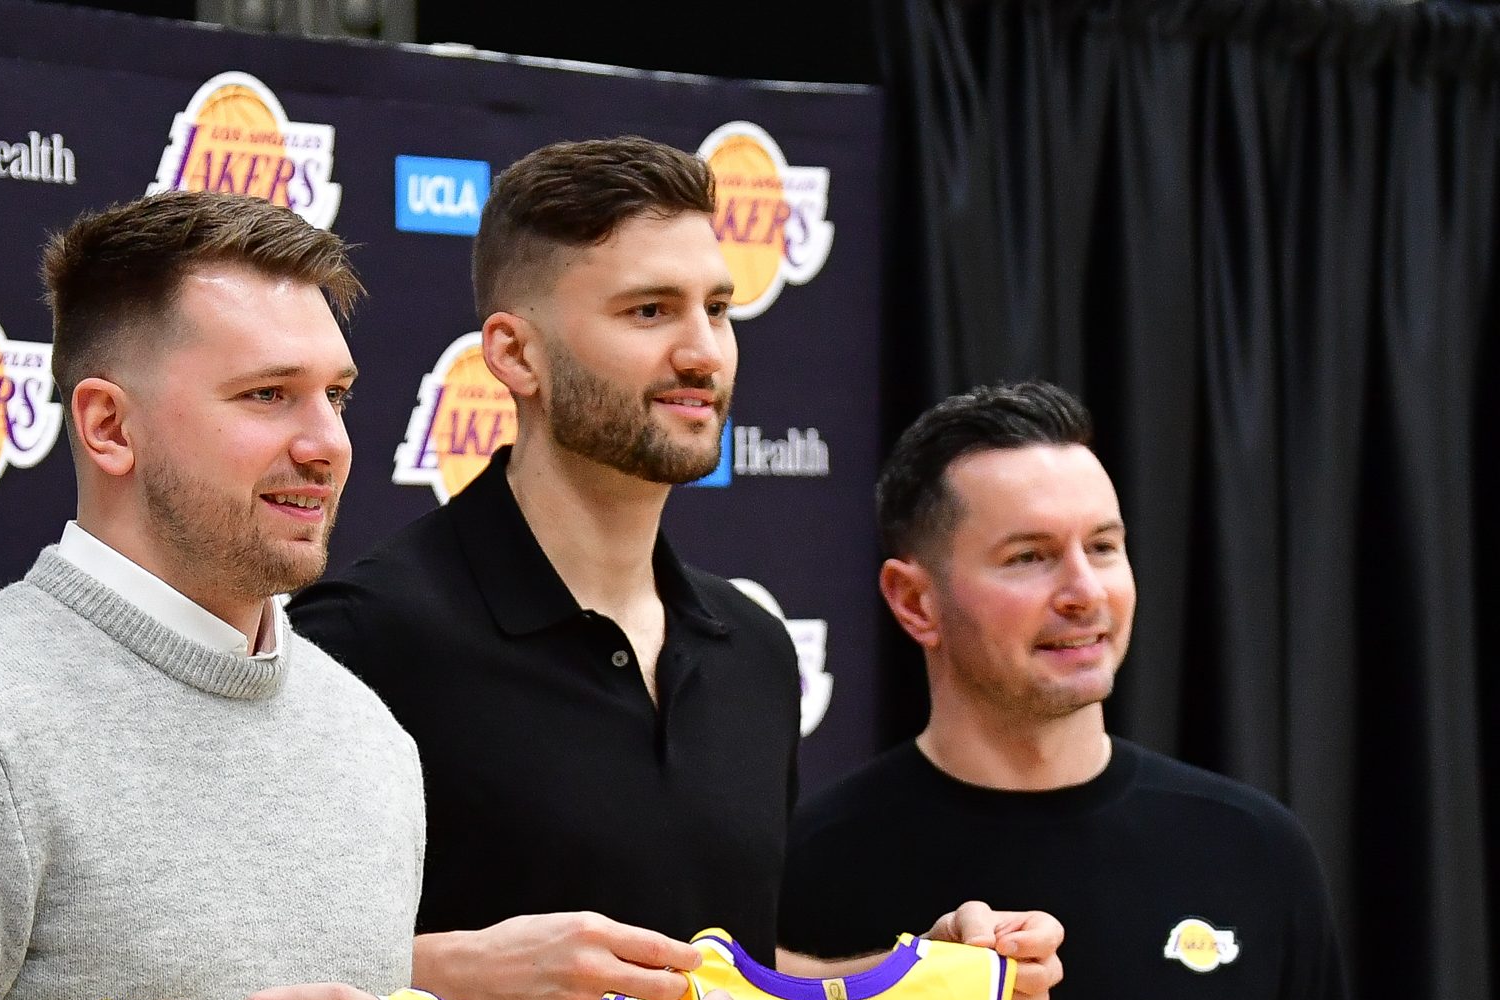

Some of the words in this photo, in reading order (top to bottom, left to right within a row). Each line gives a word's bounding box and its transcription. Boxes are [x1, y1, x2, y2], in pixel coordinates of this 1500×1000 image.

[171, 124, 323, 209] LAKERS
[408, 174, 480, 217] UCLA
[709, 197, 818, 268] KERS
[412, 385, 516, 469] LAKE
